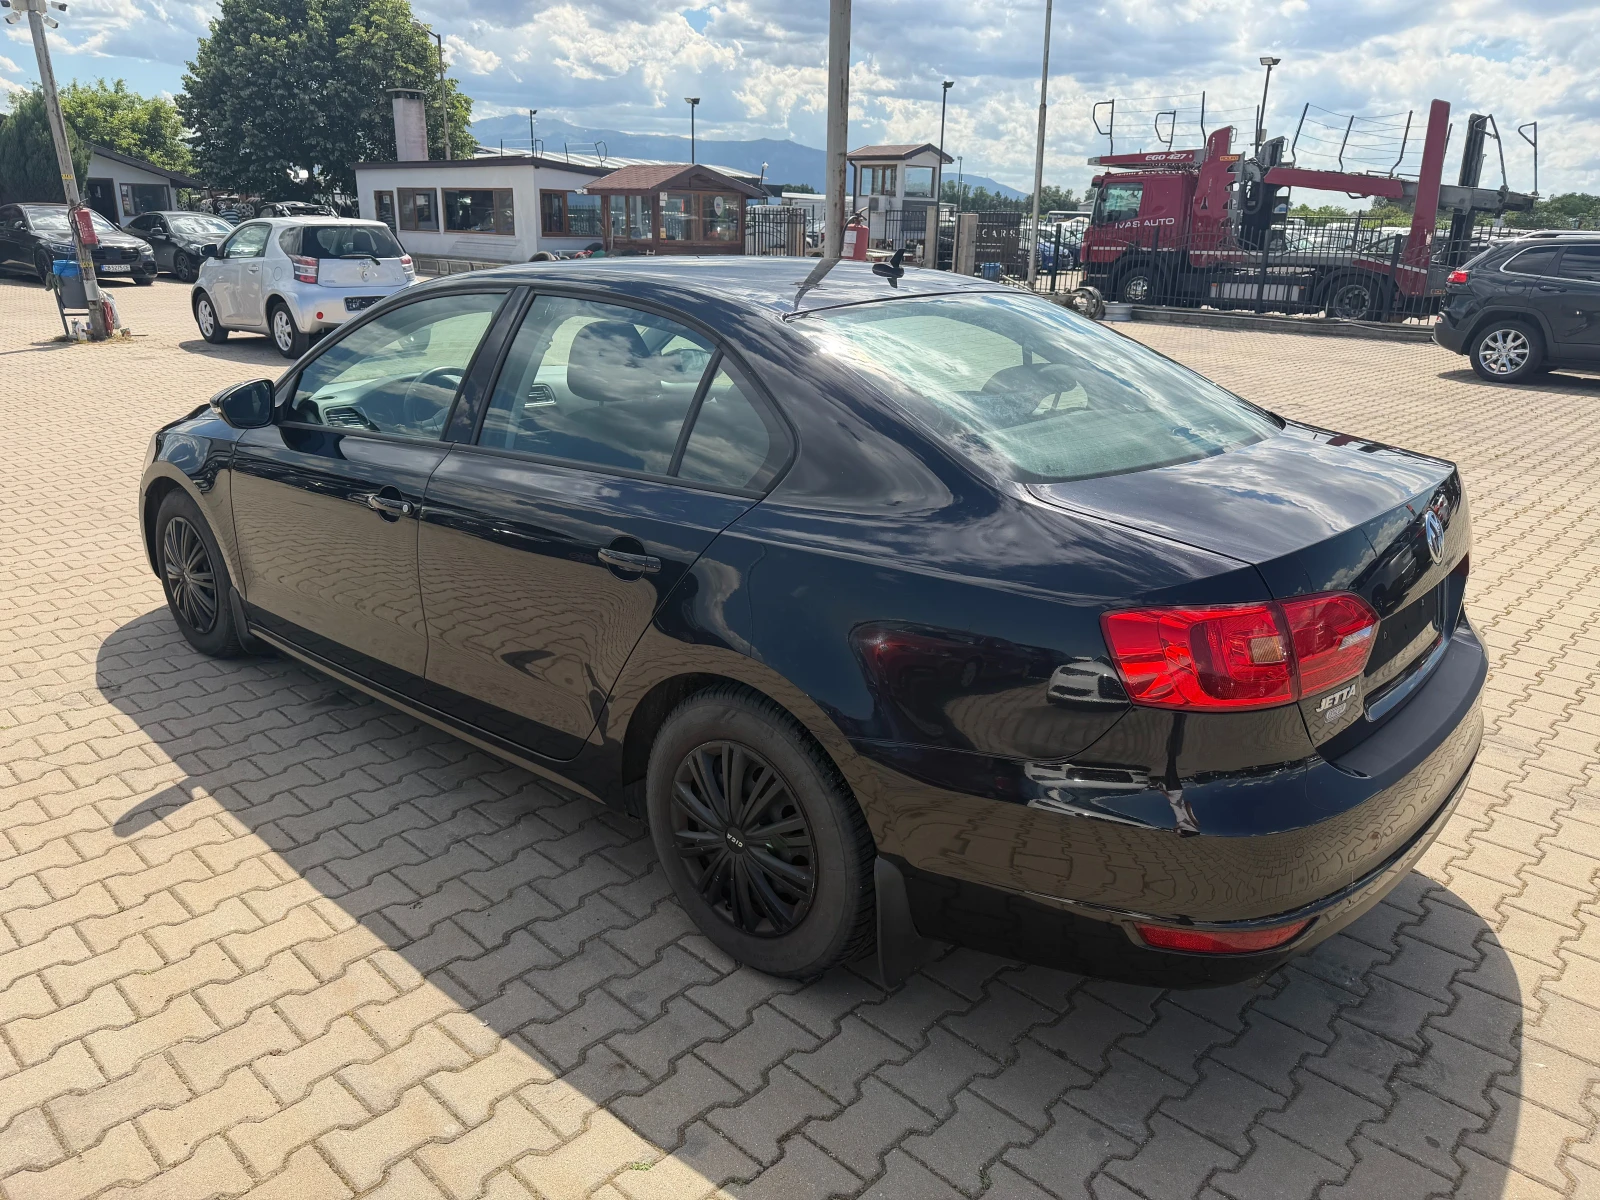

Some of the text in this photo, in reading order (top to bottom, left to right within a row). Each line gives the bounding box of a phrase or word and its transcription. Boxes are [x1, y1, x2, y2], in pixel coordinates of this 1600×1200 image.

[1115, 217, 1175, 229] IVAS AUTO
[1315, 684, 1356, 713] JETTA
